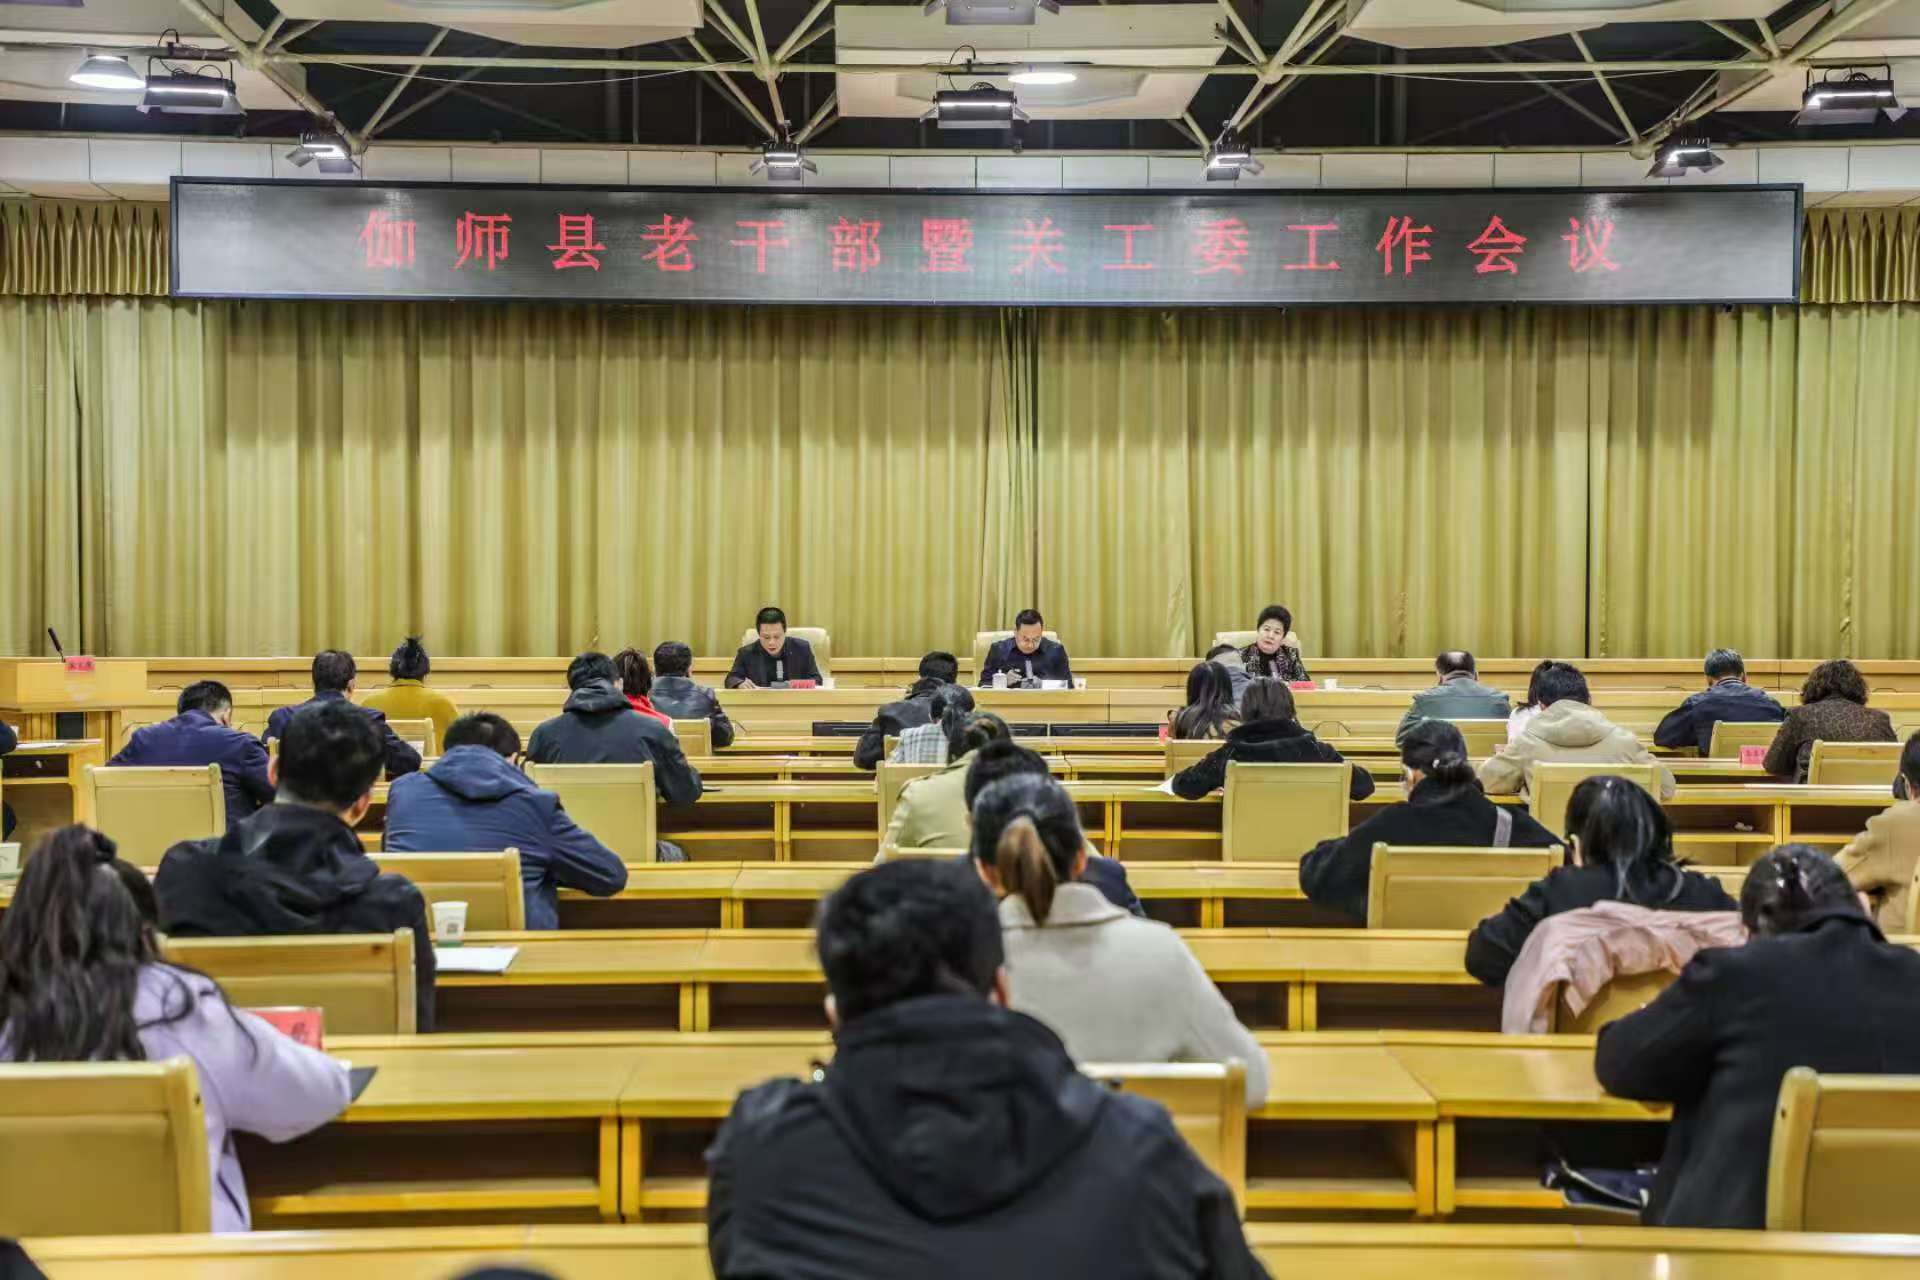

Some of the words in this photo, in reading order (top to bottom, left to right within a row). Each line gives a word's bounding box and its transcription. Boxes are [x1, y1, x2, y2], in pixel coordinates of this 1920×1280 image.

[360, 211, 1621, 274] 伽师县老干部暨关工委工作会议
